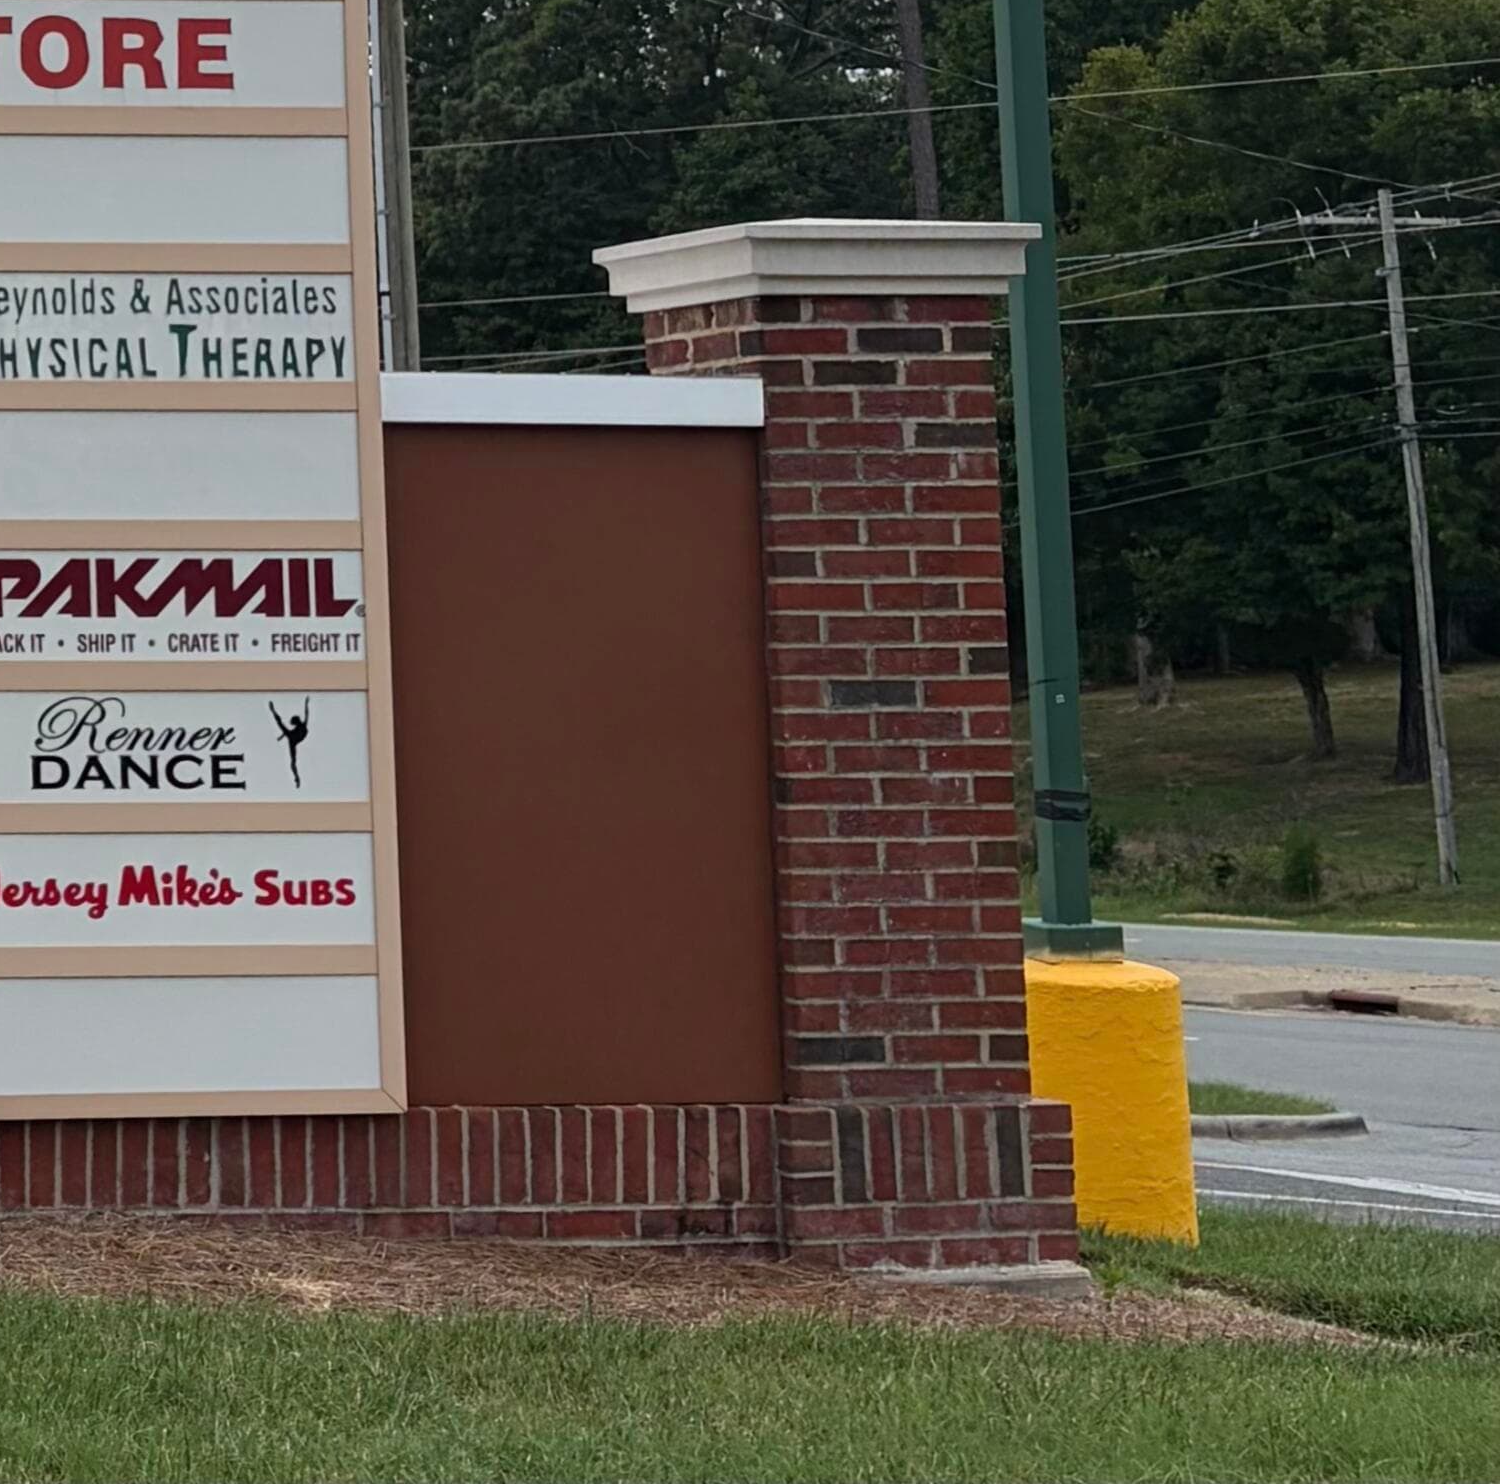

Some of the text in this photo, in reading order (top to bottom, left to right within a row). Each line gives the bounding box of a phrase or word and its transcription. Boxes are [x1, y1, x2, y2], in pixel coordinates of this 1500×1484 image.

[130, 278, 152, 315] &
[168, 323, 346, 379] THERAPY
[29, 632, 46, 654] IT
[76, 632, 117, 654] SHIP
[120, 632, 137, 653] IT
[167, 632, 220, 654] CRATE
[224, 632, 240, 653] IT
[270, 632, 341, 653] FREIGHT
[345, 631, 362, 653] IT
[33, 696, 236, 753] Renner
[30, 753, 247, 791] DANCE
